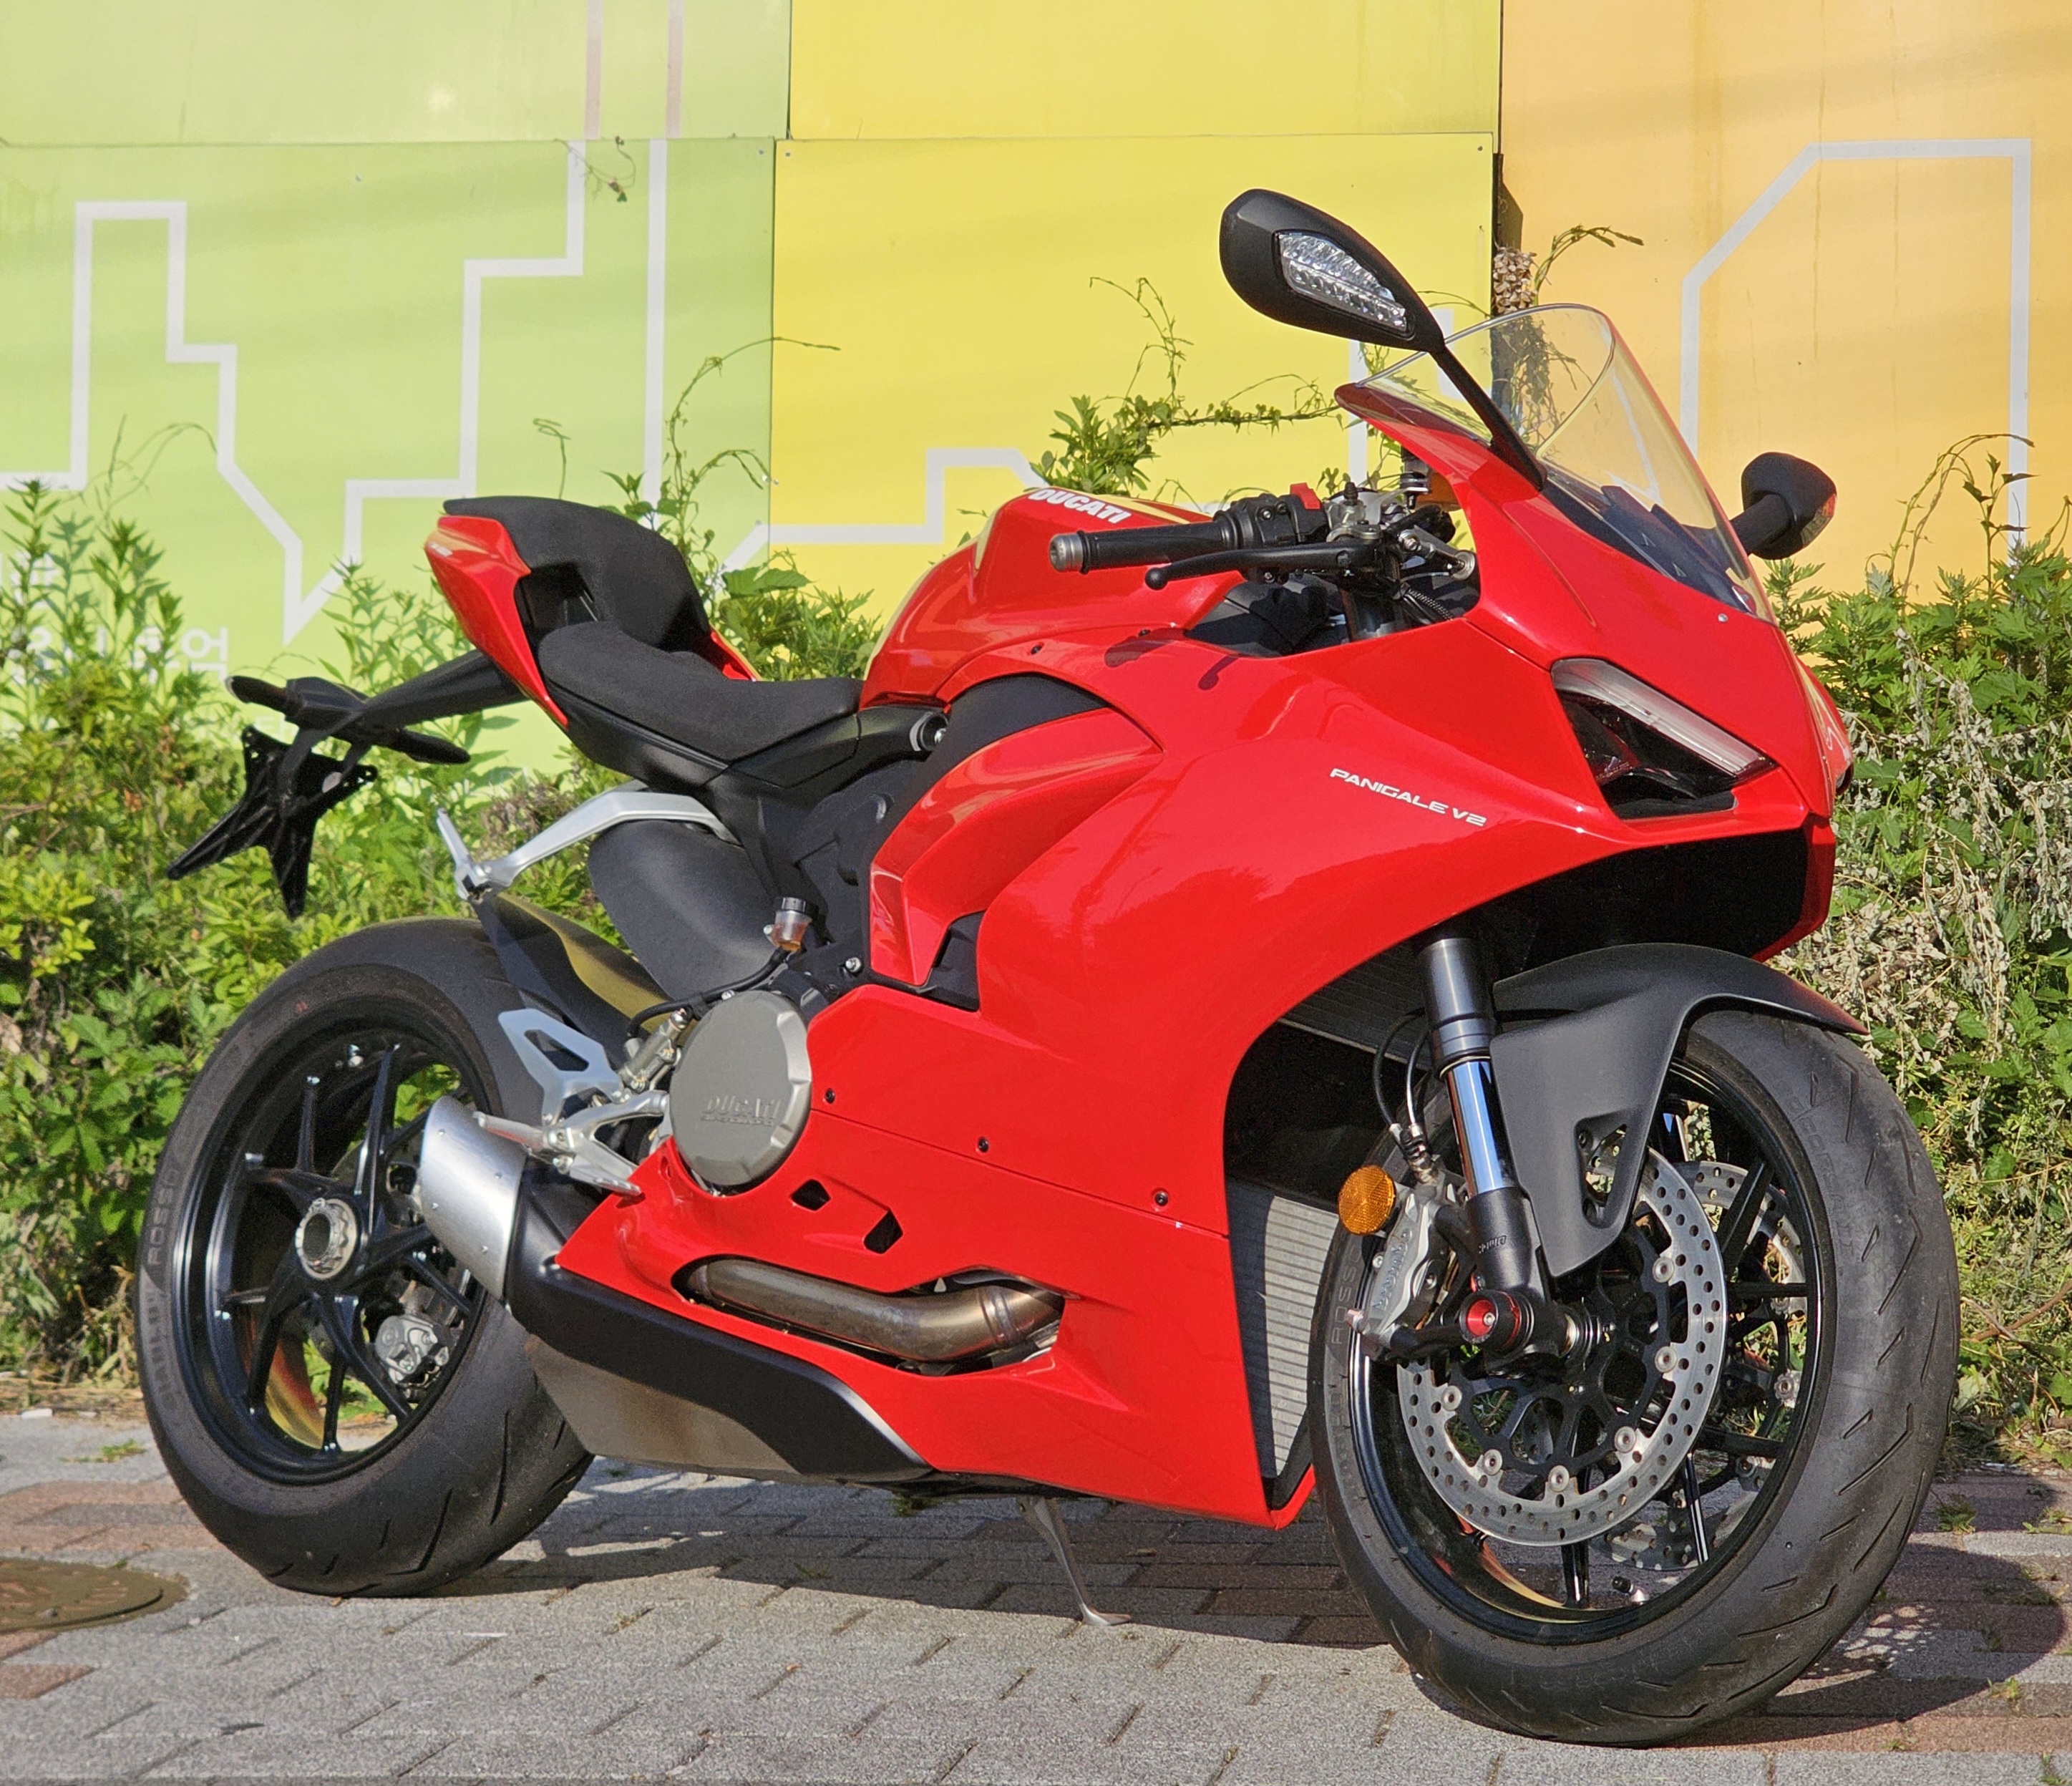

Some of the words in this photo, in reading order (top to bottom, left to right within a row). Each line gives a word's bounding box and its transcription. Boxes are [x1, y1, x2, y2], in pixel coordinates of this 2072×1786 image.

[1028, 488, 1132, 524] DUCATI
[1330, 768, 1449, 815] PANIGALE
[1452, 807, 1487, 827] V2
[147, 1168, 179, 1266] ROSSO
